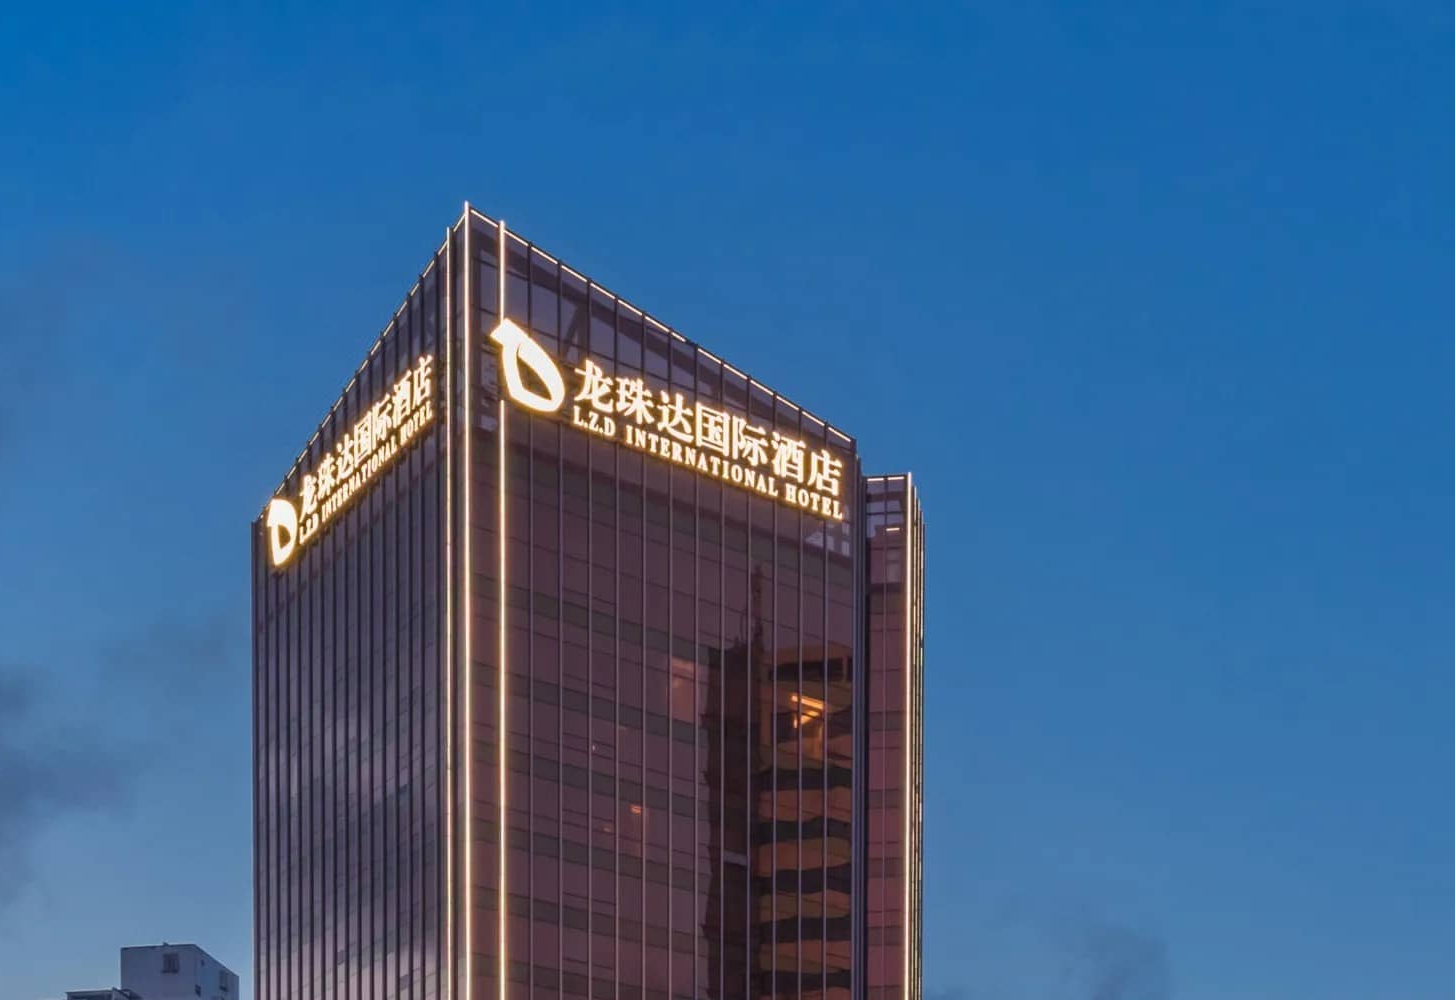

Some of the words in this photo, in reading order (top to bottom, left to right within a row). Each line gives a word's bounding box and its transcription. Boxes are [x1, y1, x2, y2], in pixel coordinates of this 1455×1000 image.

[299, 354, 433, 523] 龙珠达国际酒店
[322, 436, 397, 523] INTERNATIONAL
[401, 401, 433, 446] HOTEL
[573, 406, 616, 437] L.Z.D
[626, 425, 778, 497] INTERNATIONAL
[785, 483, 843, 521] HOTEL
[574, 359, 843, 496] 龙珠达国际酒店
